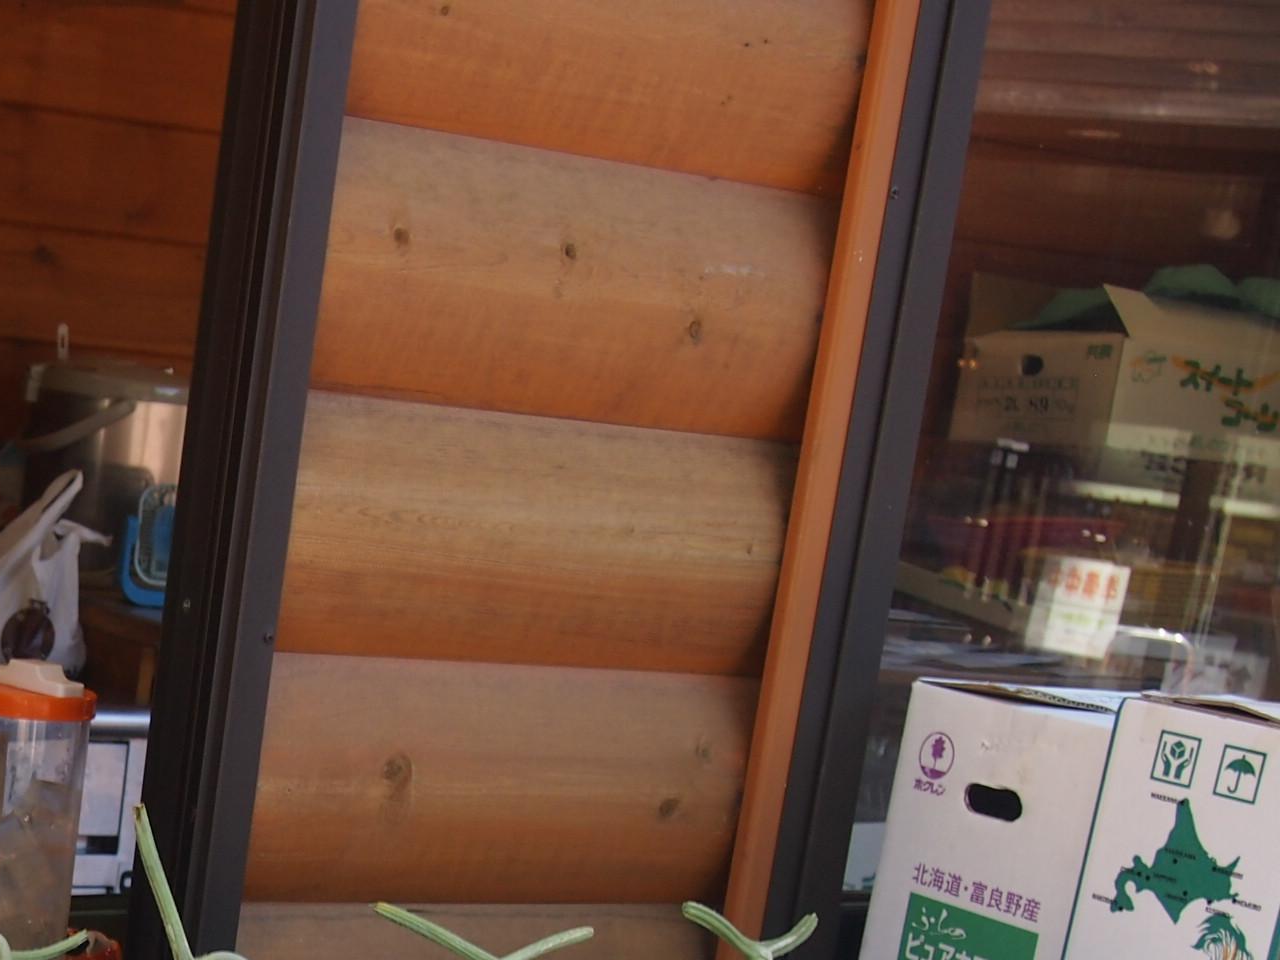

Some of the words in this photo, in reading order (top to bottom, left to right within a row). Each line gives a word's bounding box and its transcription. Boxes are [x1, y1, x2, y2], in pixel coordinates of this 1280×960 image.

[912, 862, 1041, 924] 北海道・富良野産
